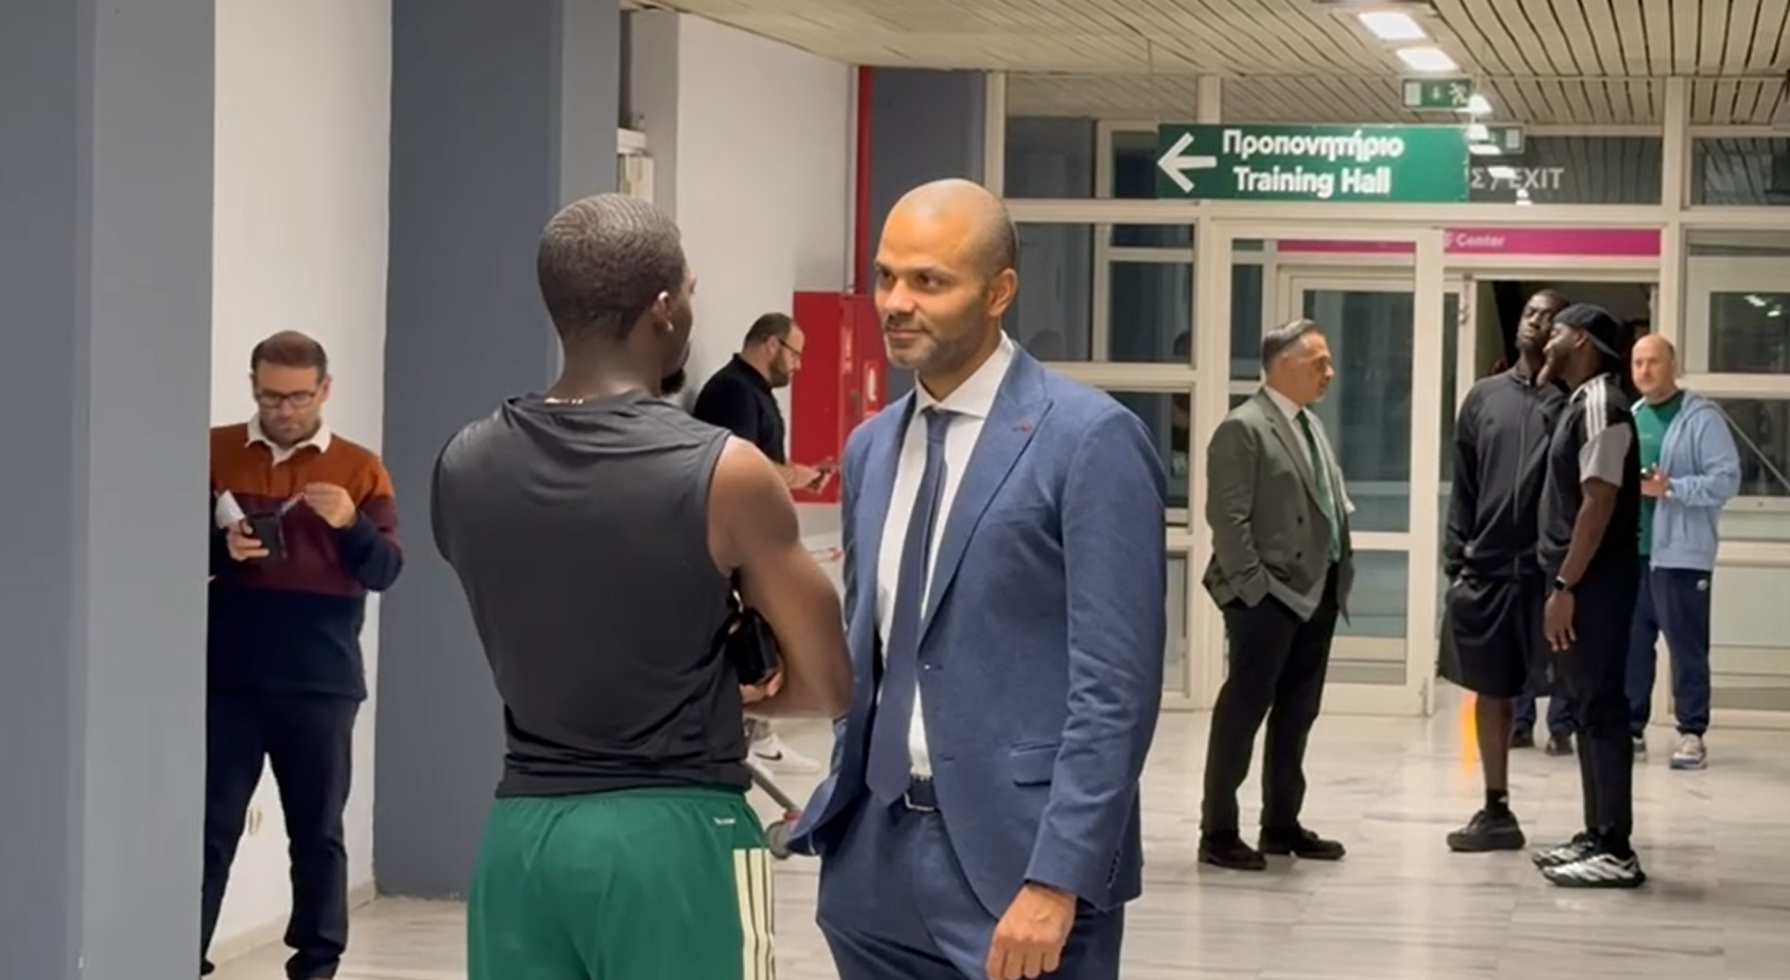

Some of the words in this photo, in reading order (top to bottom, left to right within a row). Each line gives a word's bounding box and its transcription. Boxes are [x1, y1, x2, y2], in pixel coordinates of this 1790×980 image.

[1223, 129, 1404, 162] Προπονητήριο
[1233, 166, 1334, 199] Training
[1341, 167, 1391, 193] Hall
[1508, 167, 1564, 189] EXIT
